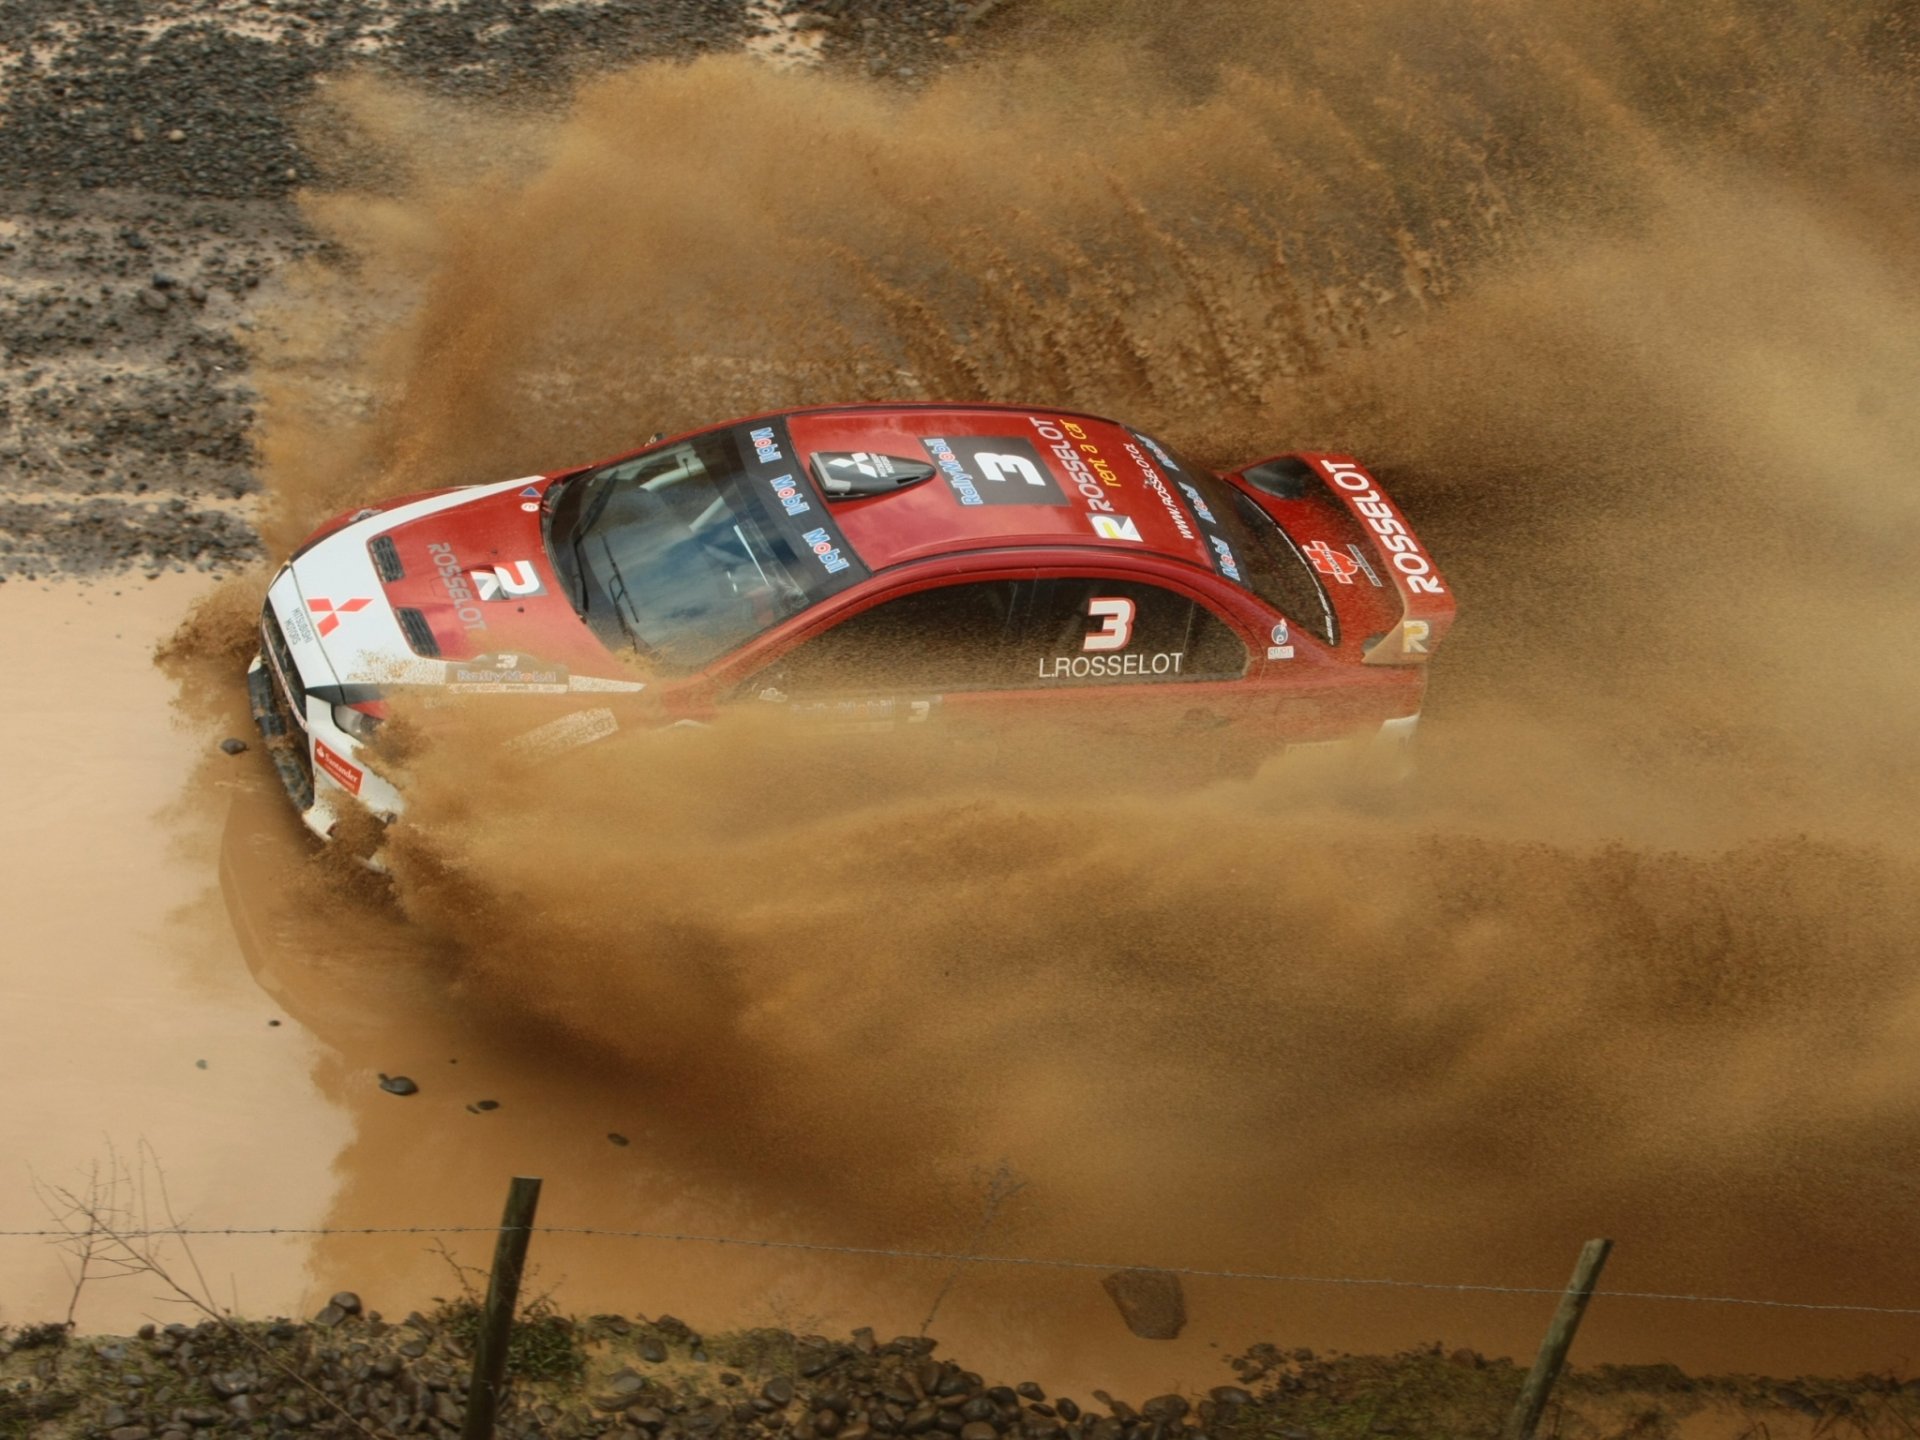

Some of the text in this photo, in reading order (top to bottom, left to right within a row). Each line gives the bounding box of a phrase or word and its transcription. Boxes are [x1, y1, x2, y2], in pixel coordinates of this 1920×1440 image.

[750, 427, 782, 463] Mobil
[1029, 416, 1115, 513] ROSSELOT
[1060, 419, 1122, 487] rent a car
[974, 452, 1046, 486] 3
[770, 474, 810, 516] Mobil
[1320, 460, 1445, 593] ROSSELOT
[802, 527, 849, 574] Mobil
[1209, 535, 1241, 581] Mobil
[427, 542, 488, 631] ROSSELOT
[1083, 597, 1136, 652] 3
[496, 654, 518, 668] 3
[1039, 652, 1183, 678] L.ROSSELOT
